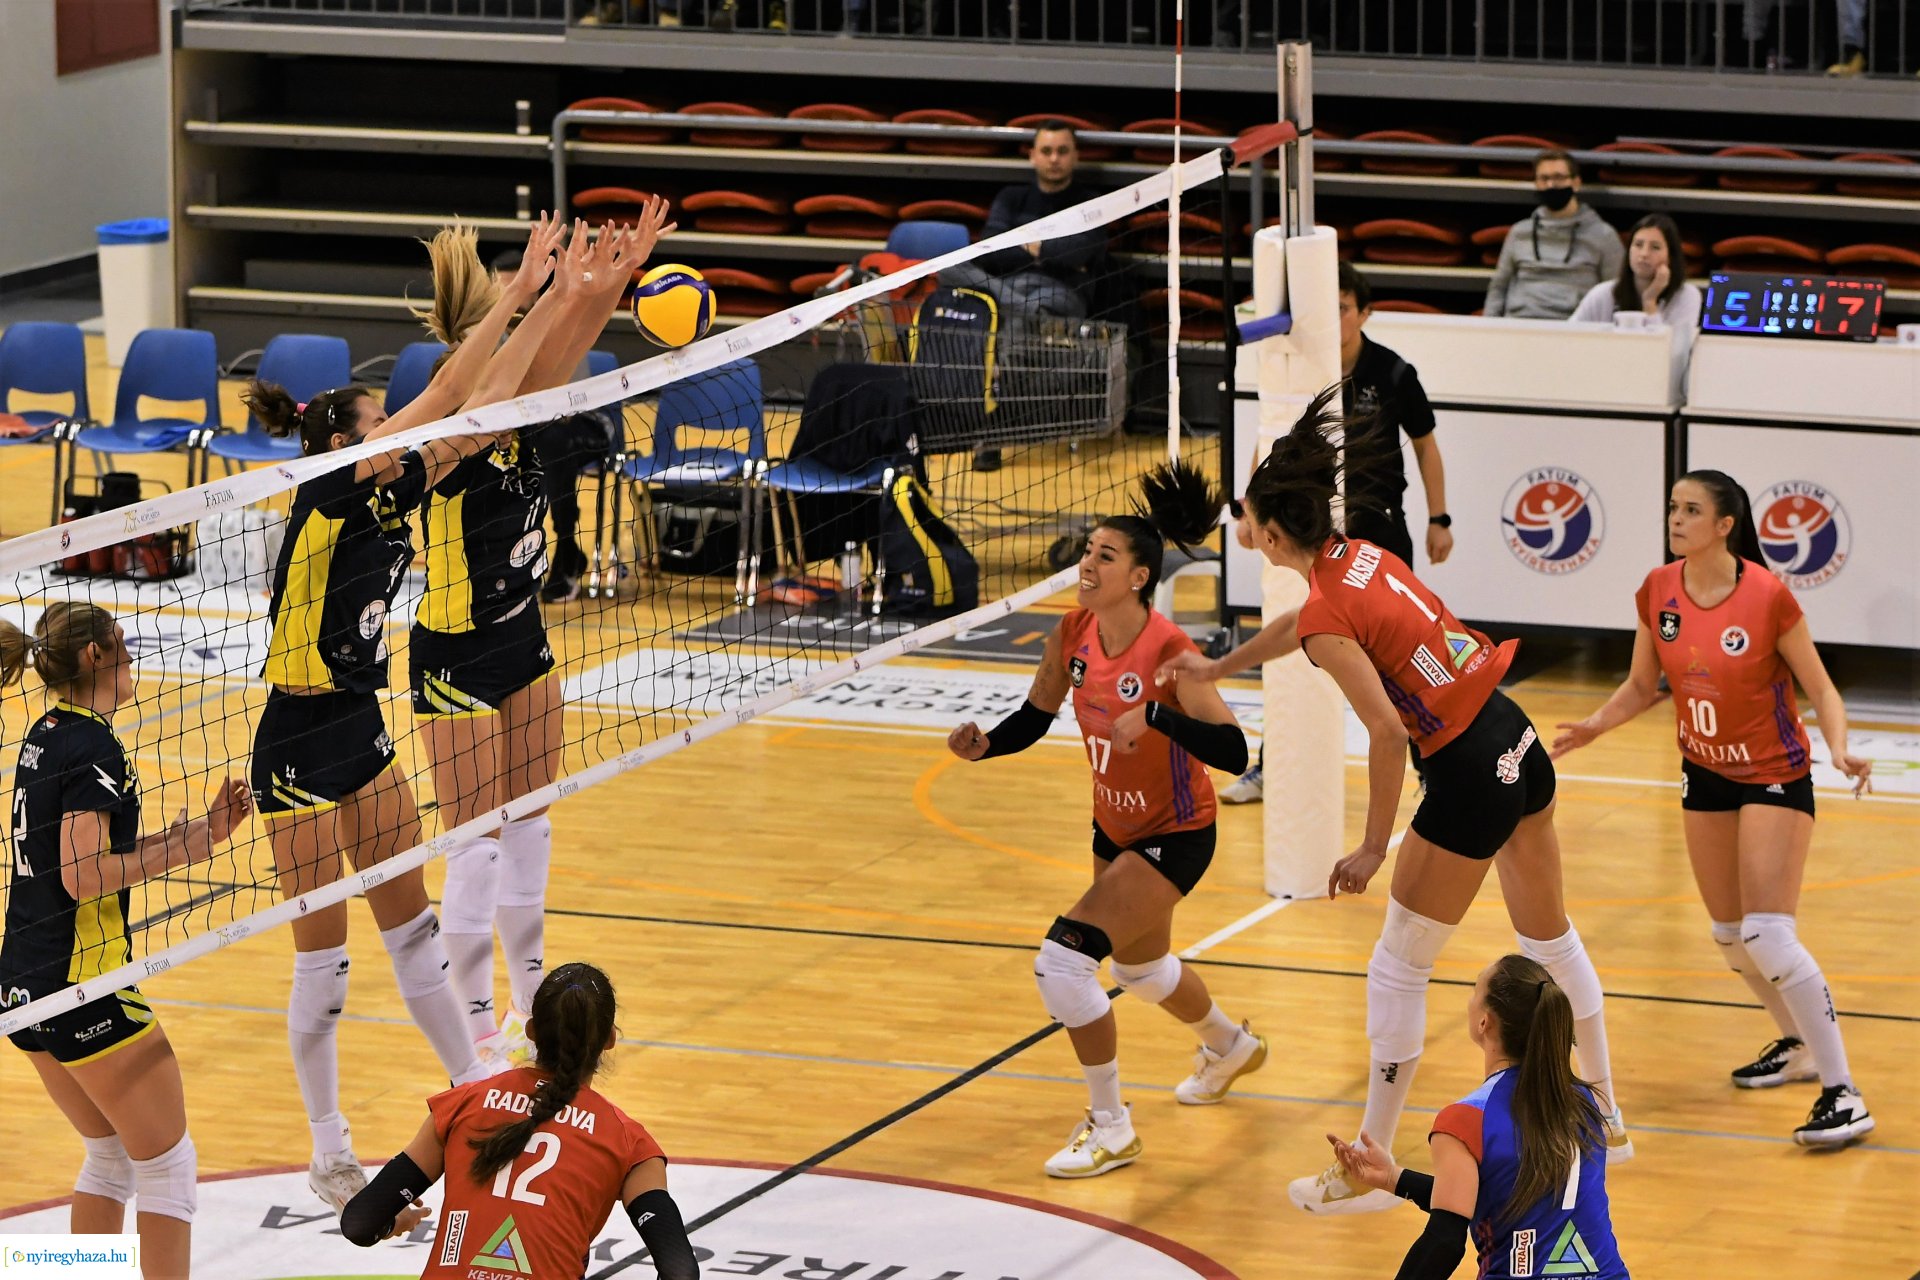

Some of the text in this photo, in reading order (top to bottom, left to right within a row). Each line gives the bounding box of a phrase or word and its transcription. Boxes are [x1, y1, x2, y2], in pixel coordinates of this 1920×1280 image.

[1721, 292, 1751, 327] 5
[1837, 297, 1865, 333] 7
[1527, 470, 1579, 485] FATUM
[1773, 483, 1825, 499] FATUM
[204, 488, 235, 508] FATUM
[1385, 573, 1438, 622] 1
[1687, 697, 1717, 737] 10
[1087, 735, 1112, 775] 17
[1680, 720, 1751, 763] FATUM
[361, 872, 386, 888] FATUM
[144, 958, 171, 975] FATUM
[492, 1131, 561, 1206] 12
[447, 1212, 463, 1263] STRABAG
